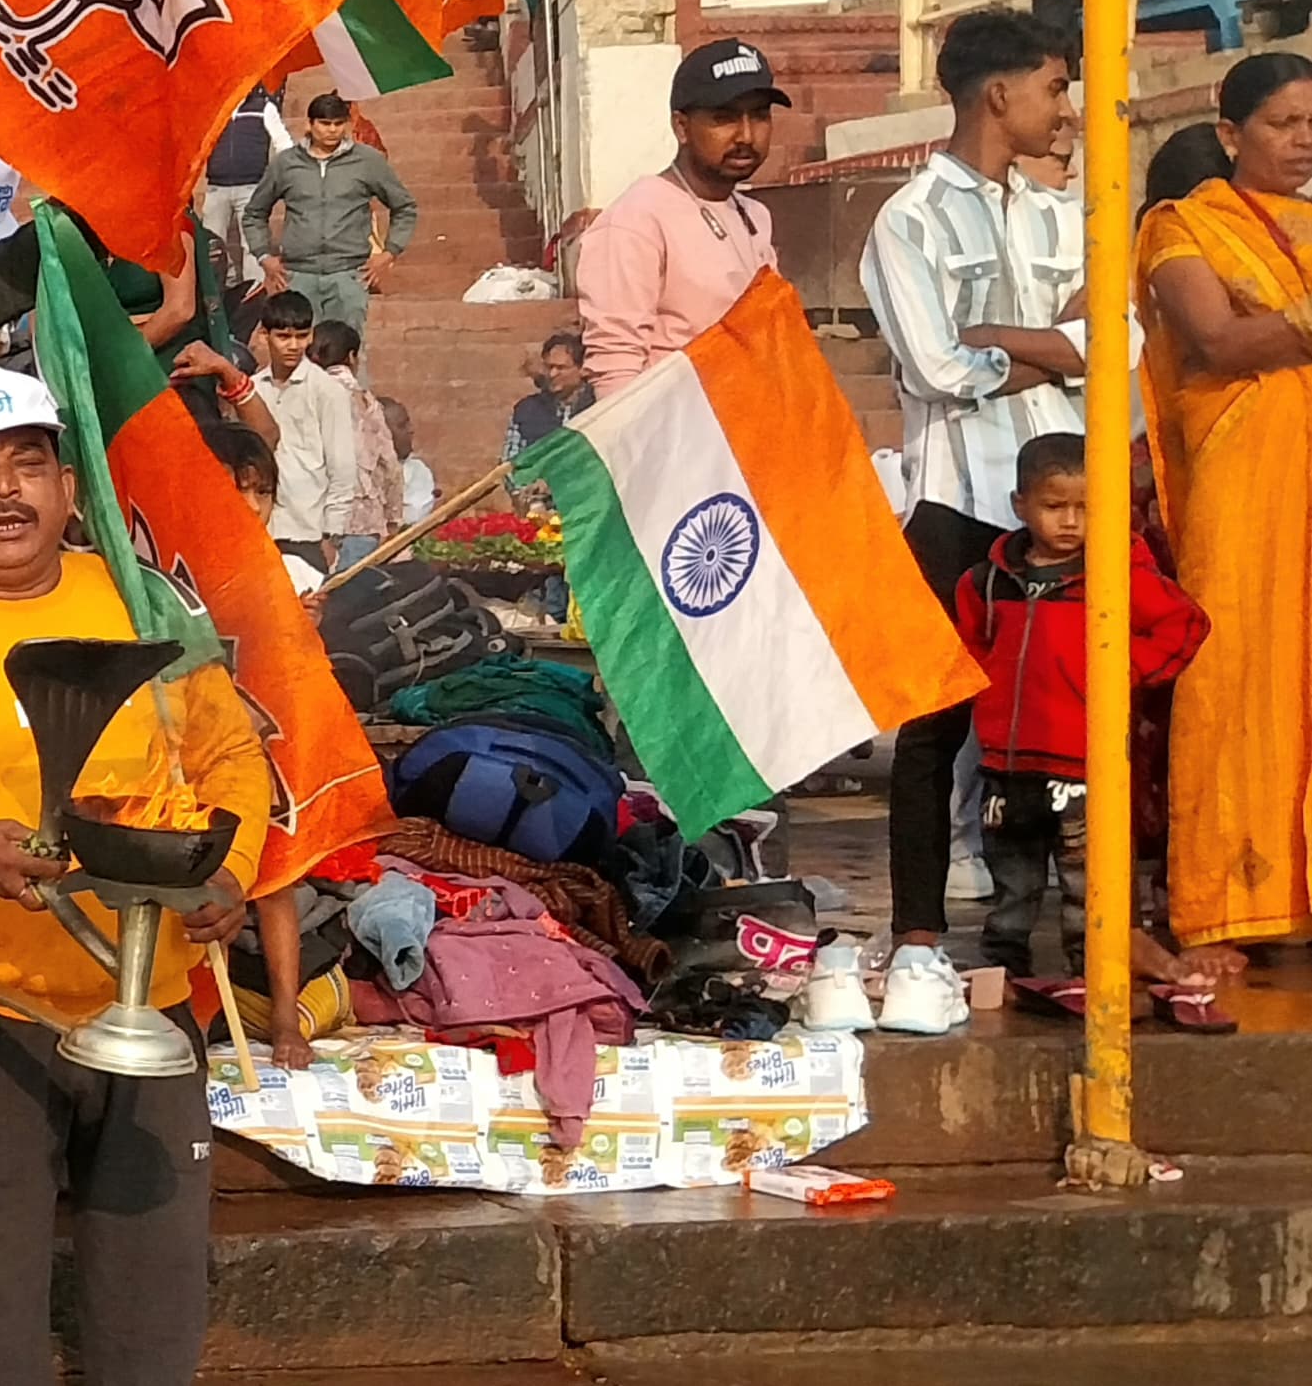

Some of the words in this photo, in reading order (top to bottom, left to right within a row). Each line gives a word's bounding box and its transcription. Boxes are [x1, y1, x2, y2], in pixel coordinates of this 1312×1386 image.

[712, 56, 762, 79] PUMA
[746, 1050, 783, 1073] Bites
[761, 1060, 795, 1087] Little
[209, 1087, 232, 1107] Bit
[376, 1075, 414, 1097] Bites
[391, 1086, 427, 1113] Little
